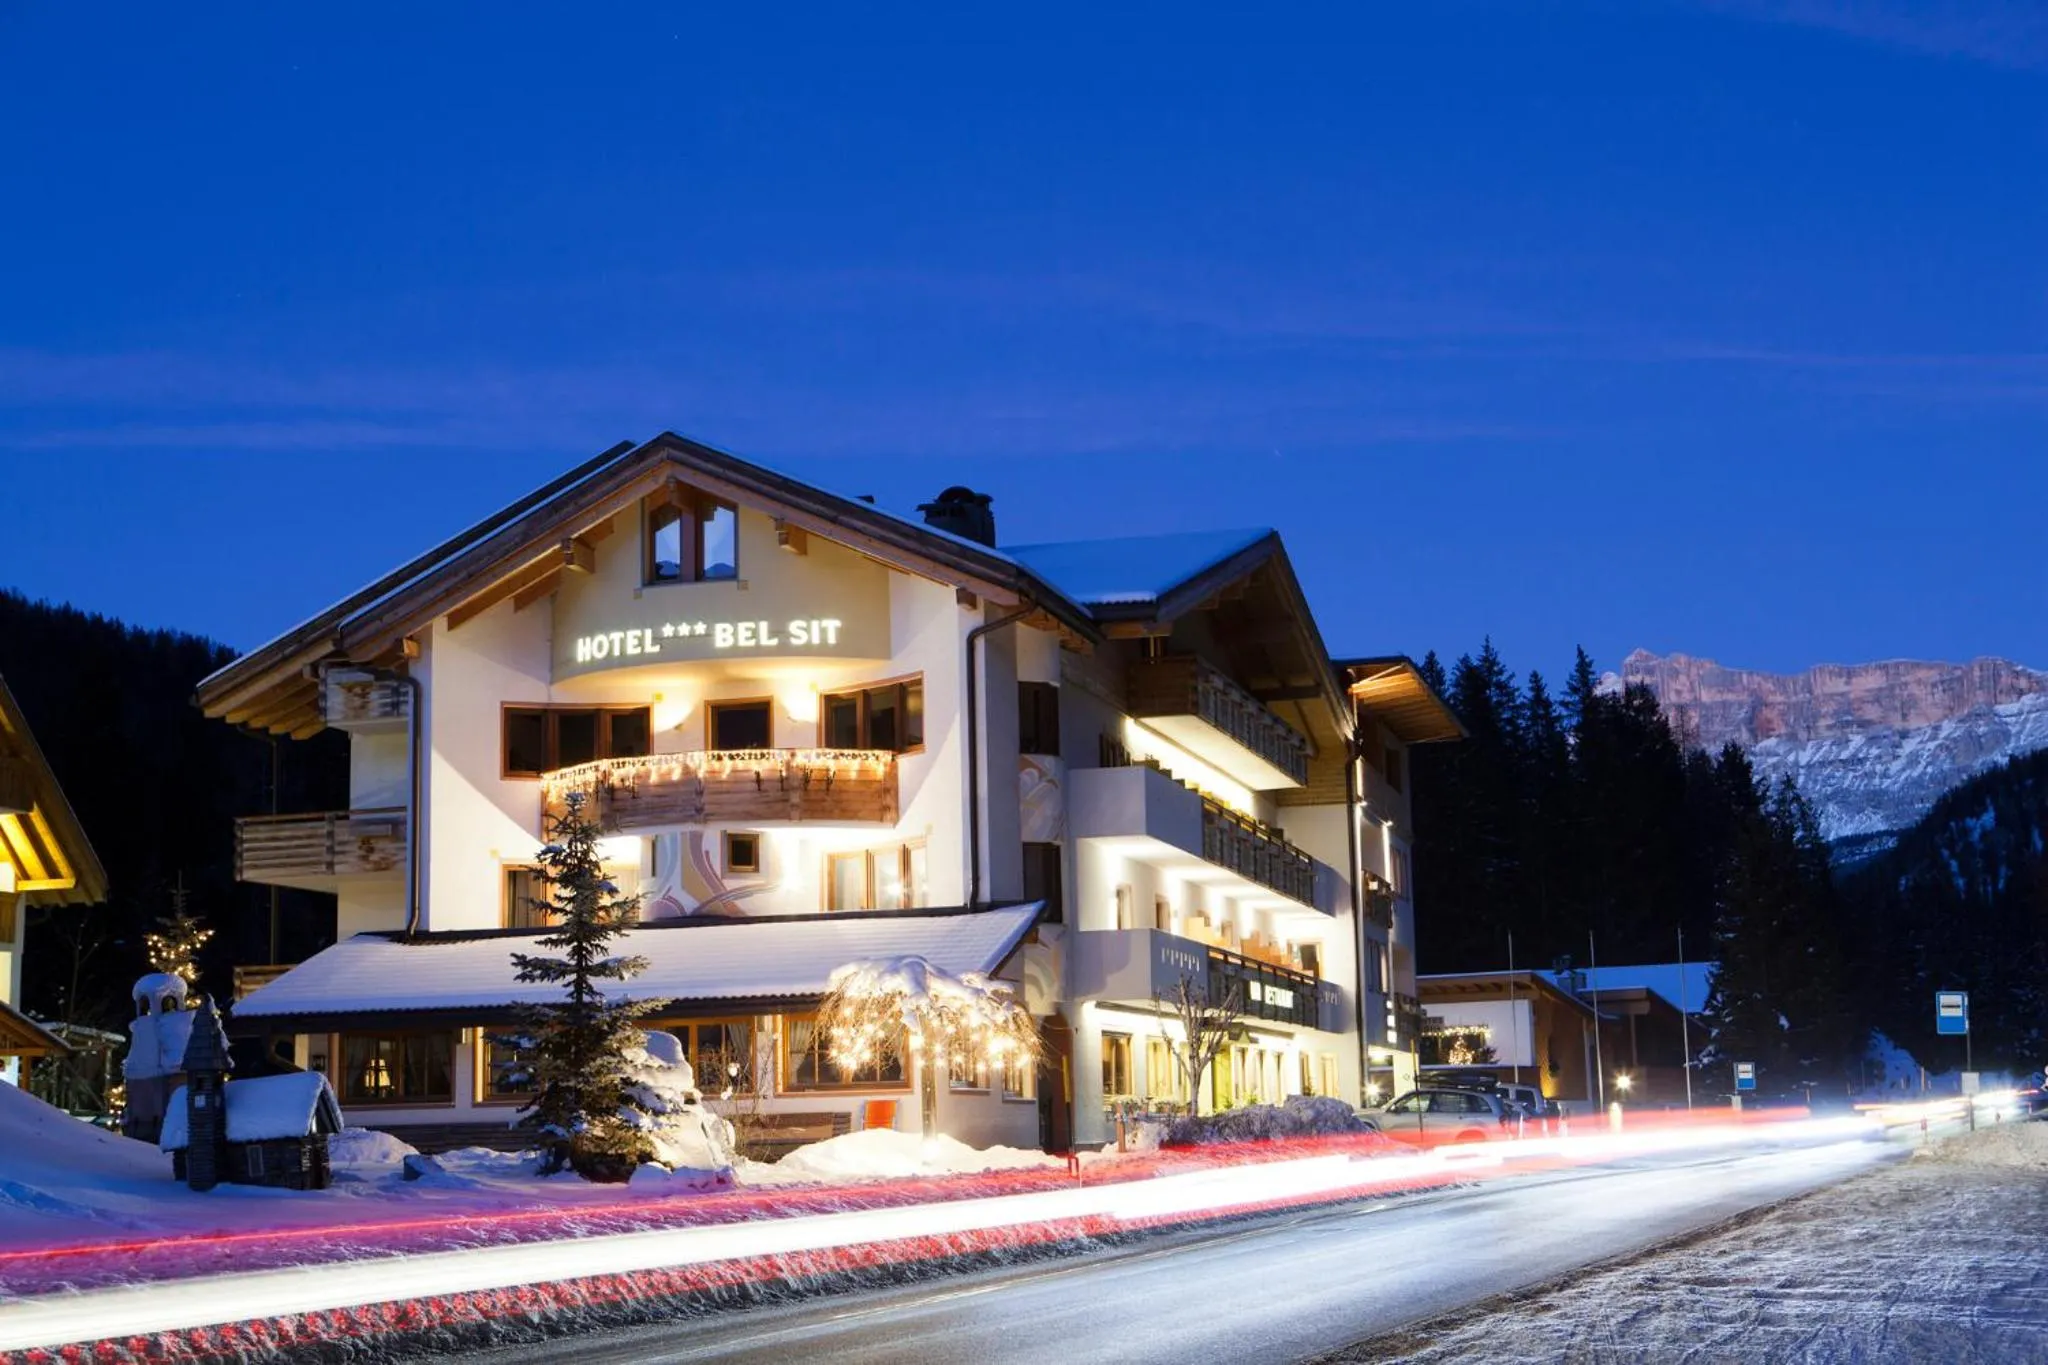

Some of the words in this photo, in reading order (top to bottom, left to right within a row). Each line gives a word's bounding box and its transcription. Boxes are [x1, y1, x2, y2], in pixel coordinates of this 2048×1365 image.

[575, 628, 661, 662] HOTEL
[714, 621, 778, 648] BEL
[788, 618, 842, 645] SIT
